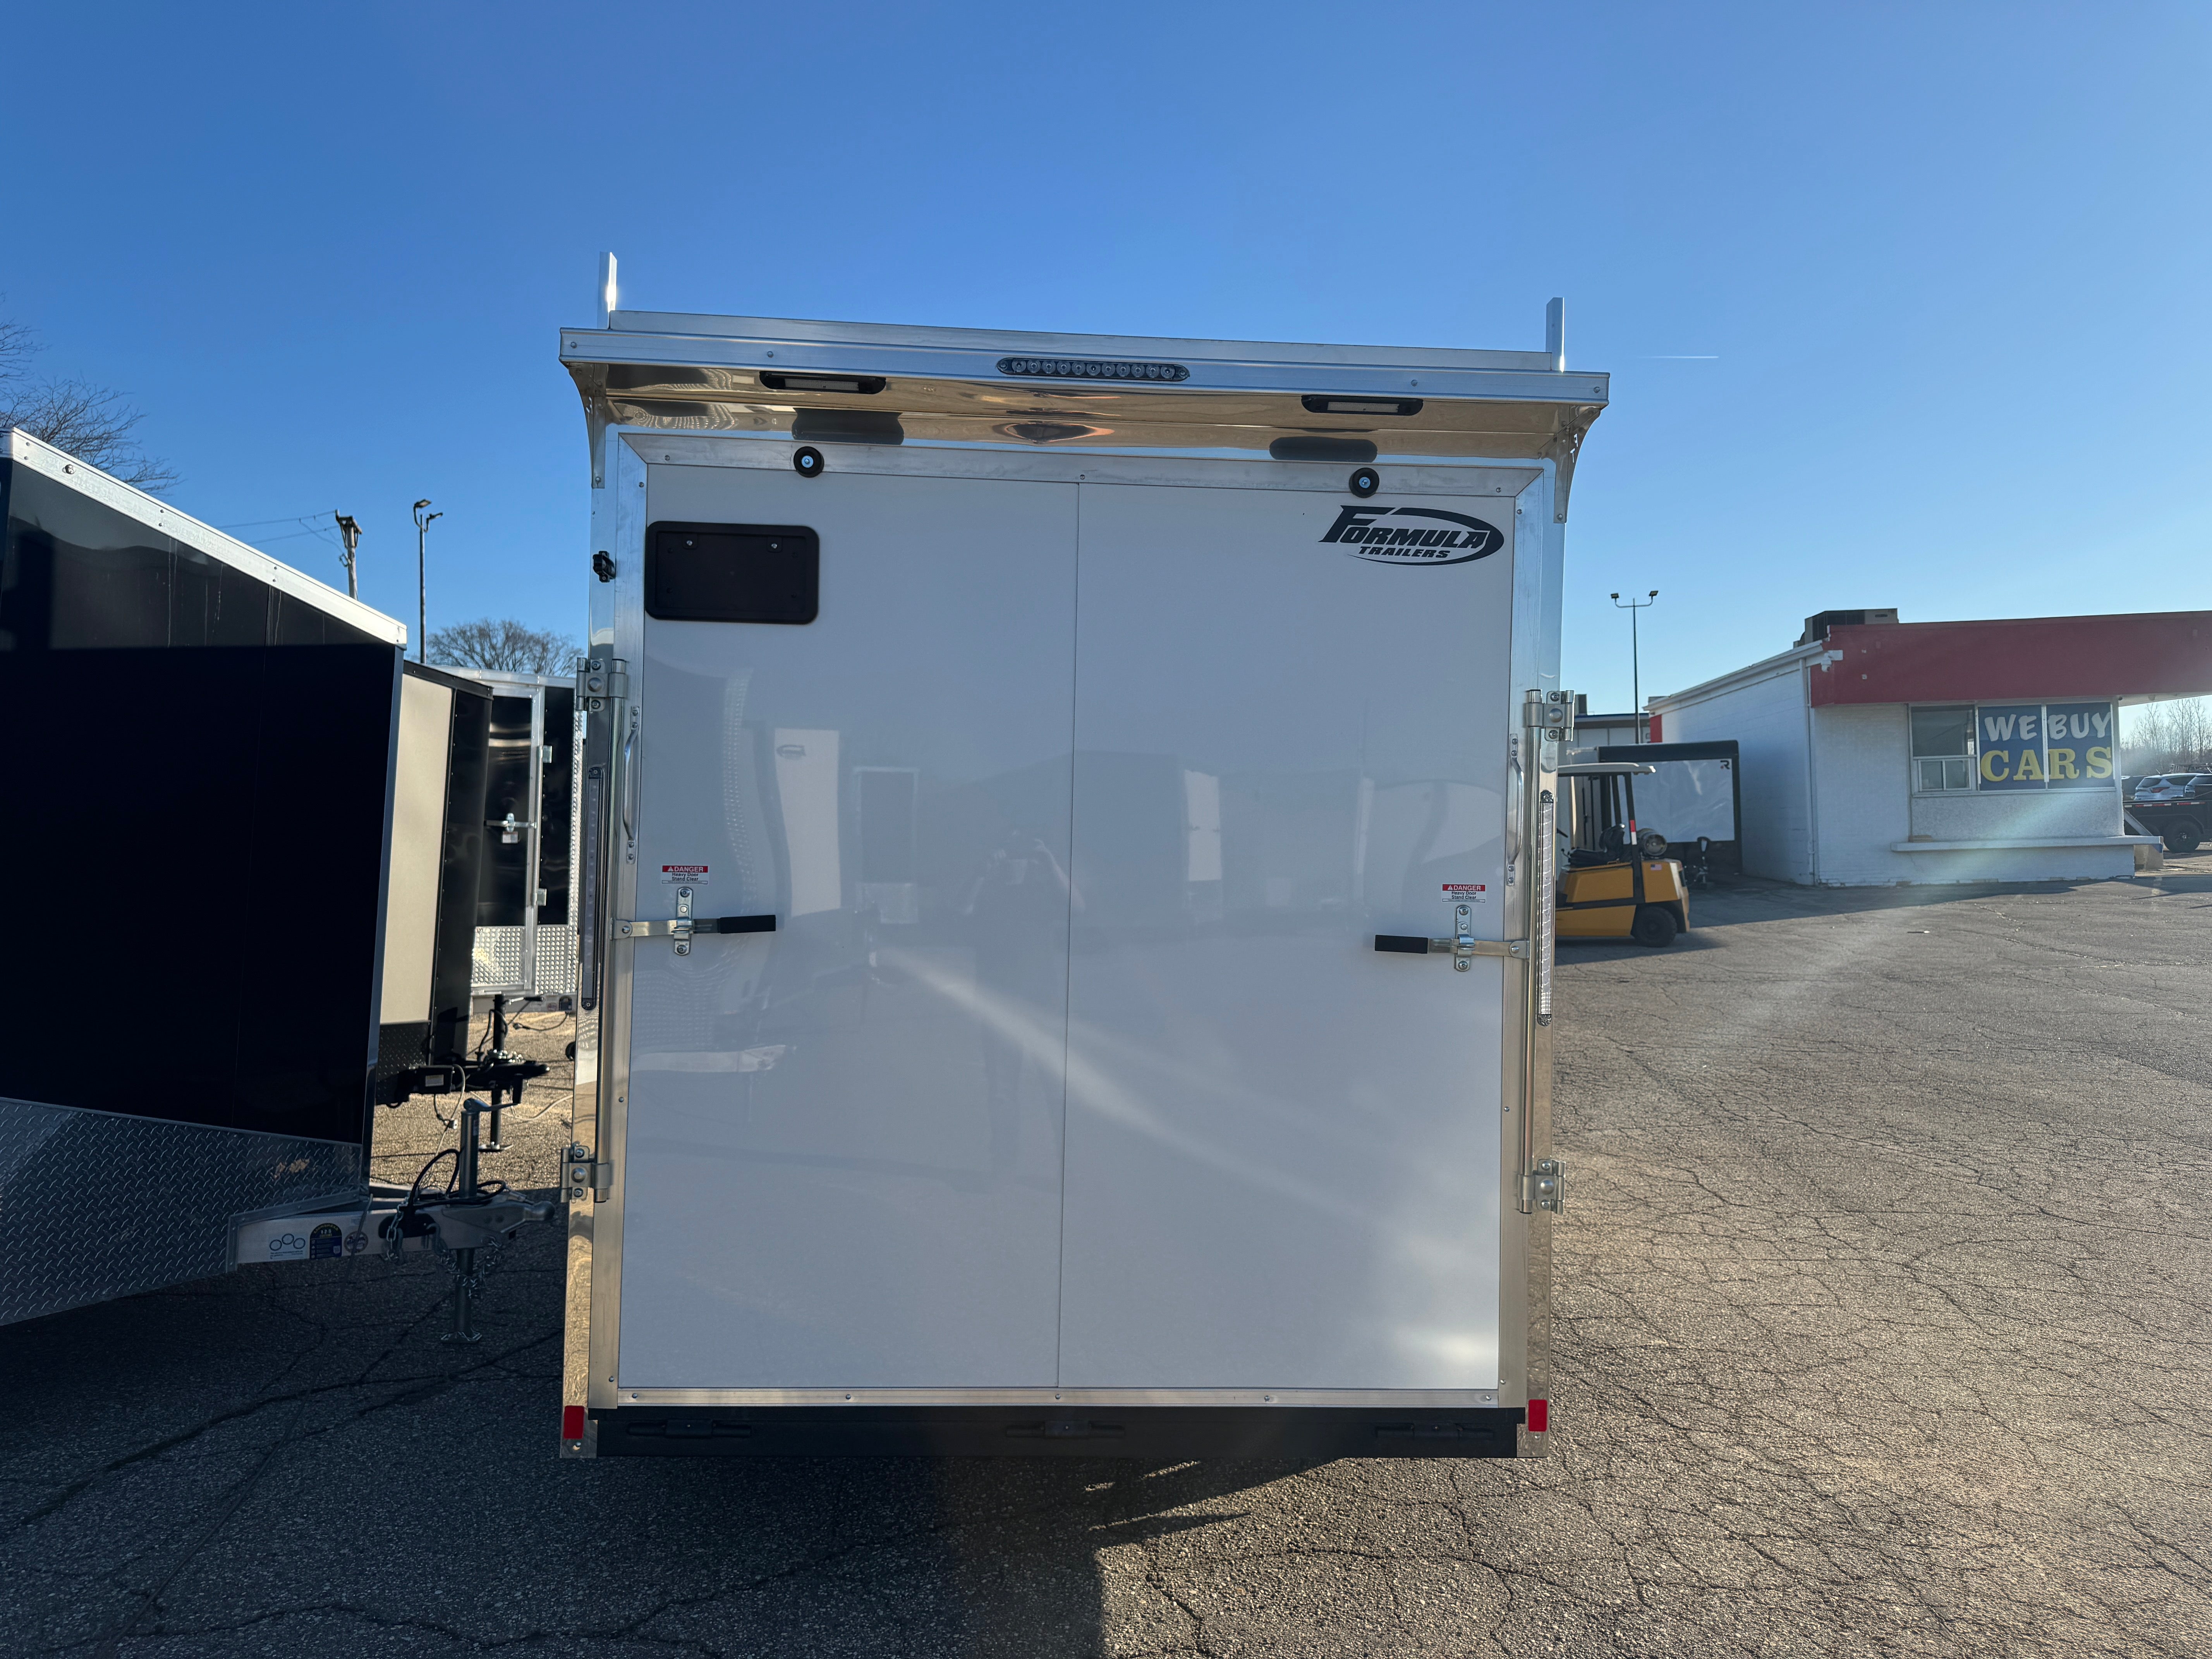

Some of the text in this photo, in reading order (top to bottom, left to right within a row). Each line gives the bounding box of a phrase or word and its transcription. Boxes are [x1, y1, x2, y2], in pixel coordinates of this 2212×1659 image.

[1318, 505, 1490, 549] FORMULA
[1358, 546, 1451, 558] TRAILERS
[1984, 712, 2111, 742] WE BUY
[1980, 746, 2113, 782] CARS
